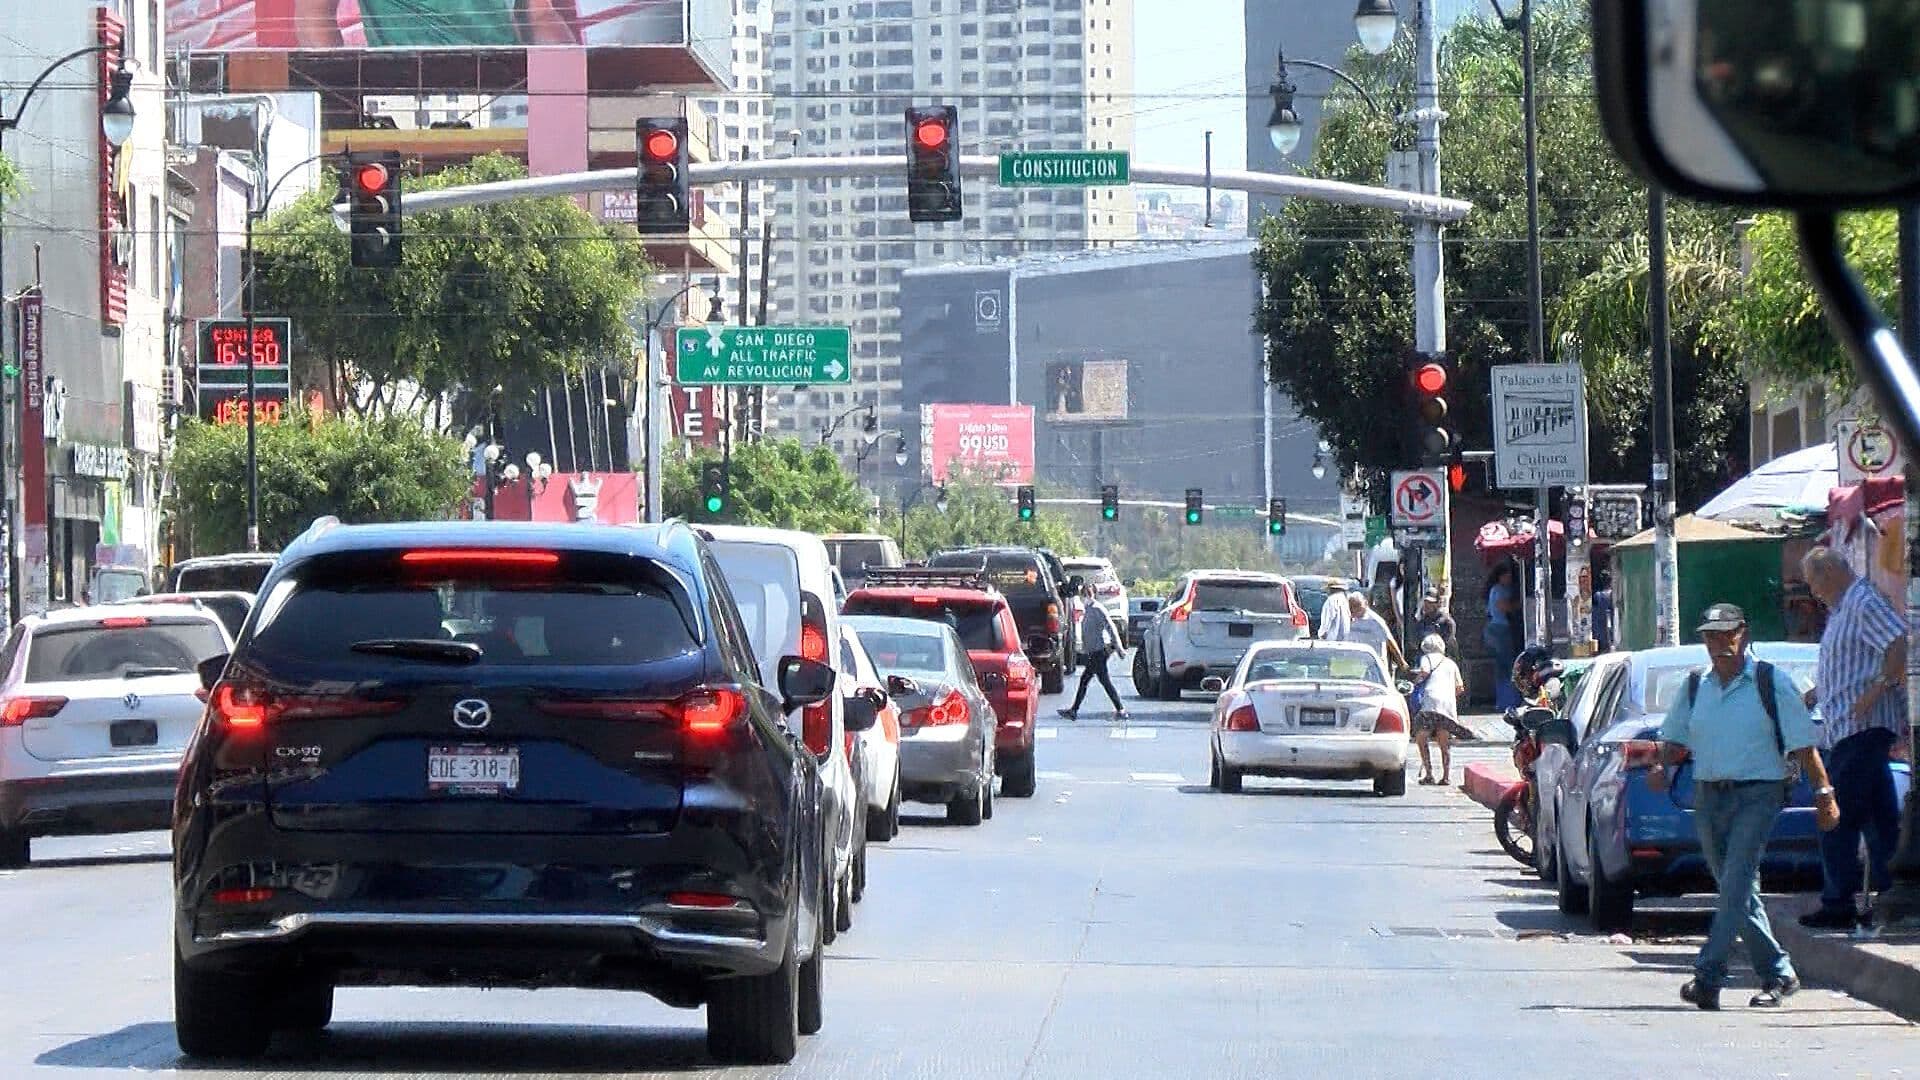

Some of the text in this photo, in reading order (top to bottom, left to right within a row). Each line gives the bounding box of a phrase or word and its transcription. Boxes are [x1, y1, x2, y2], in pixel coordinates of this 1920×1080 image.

[1013, 159, 1117, 177] CONSTITUCION
[735, 333, 815, 346] SAN DIEGO
[730, 350, 817, 362] ALL TRAFFIC
[703, 365, 813, 378] AV REVOLUCION
[1500, 371, 1577, 387] Palacio de la
[959, 435, 1009, 457] 99 USD
[1517, 451, 1569, 466] Cultura
[1509, 467, 1576, 484] de Tijuana
[430, 757, 518, 779] CDE-318-A
